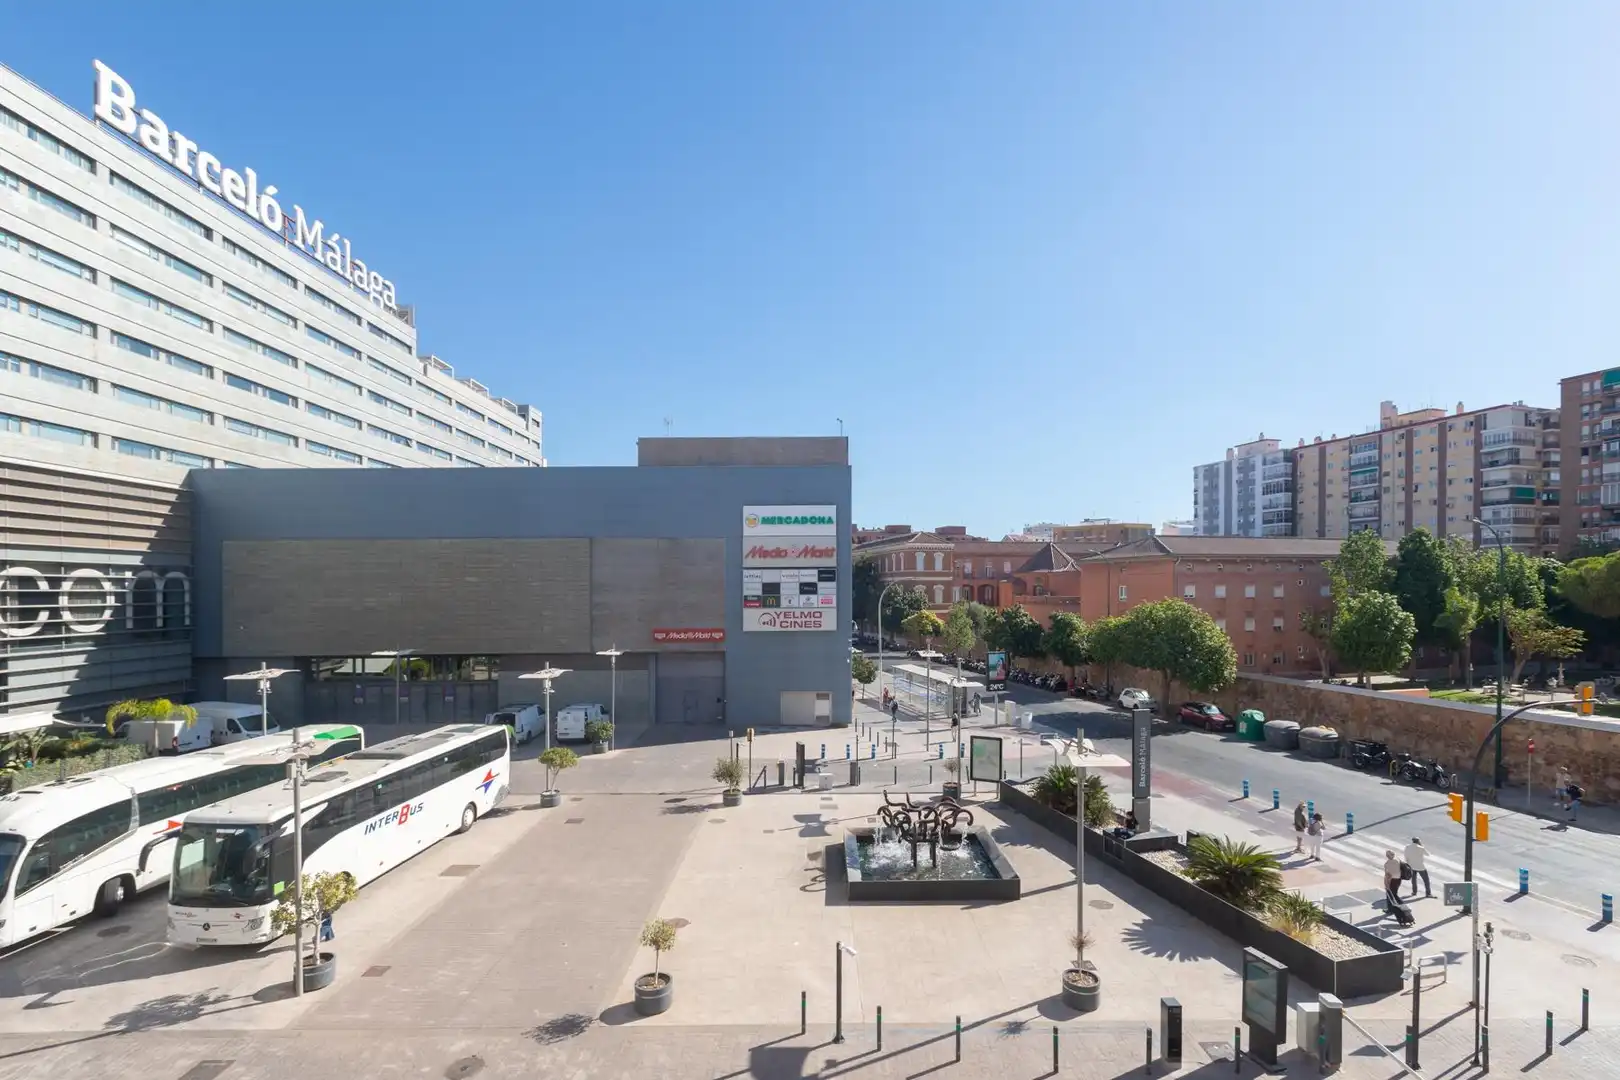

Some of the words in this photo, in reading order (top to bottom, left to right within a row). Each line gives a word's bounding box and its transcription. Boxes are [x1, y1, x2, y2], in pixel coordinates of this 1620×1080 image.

[93, 59, 283, 232] Barceló
[293, 205, 398, 310] Málaga
[761, 515, 834, 525] MERCADONA
[774, 611, 823, 619] YELMO
[780, 620, 822, 629] CINES
[364, 802, 424, 835] INTERBUS
